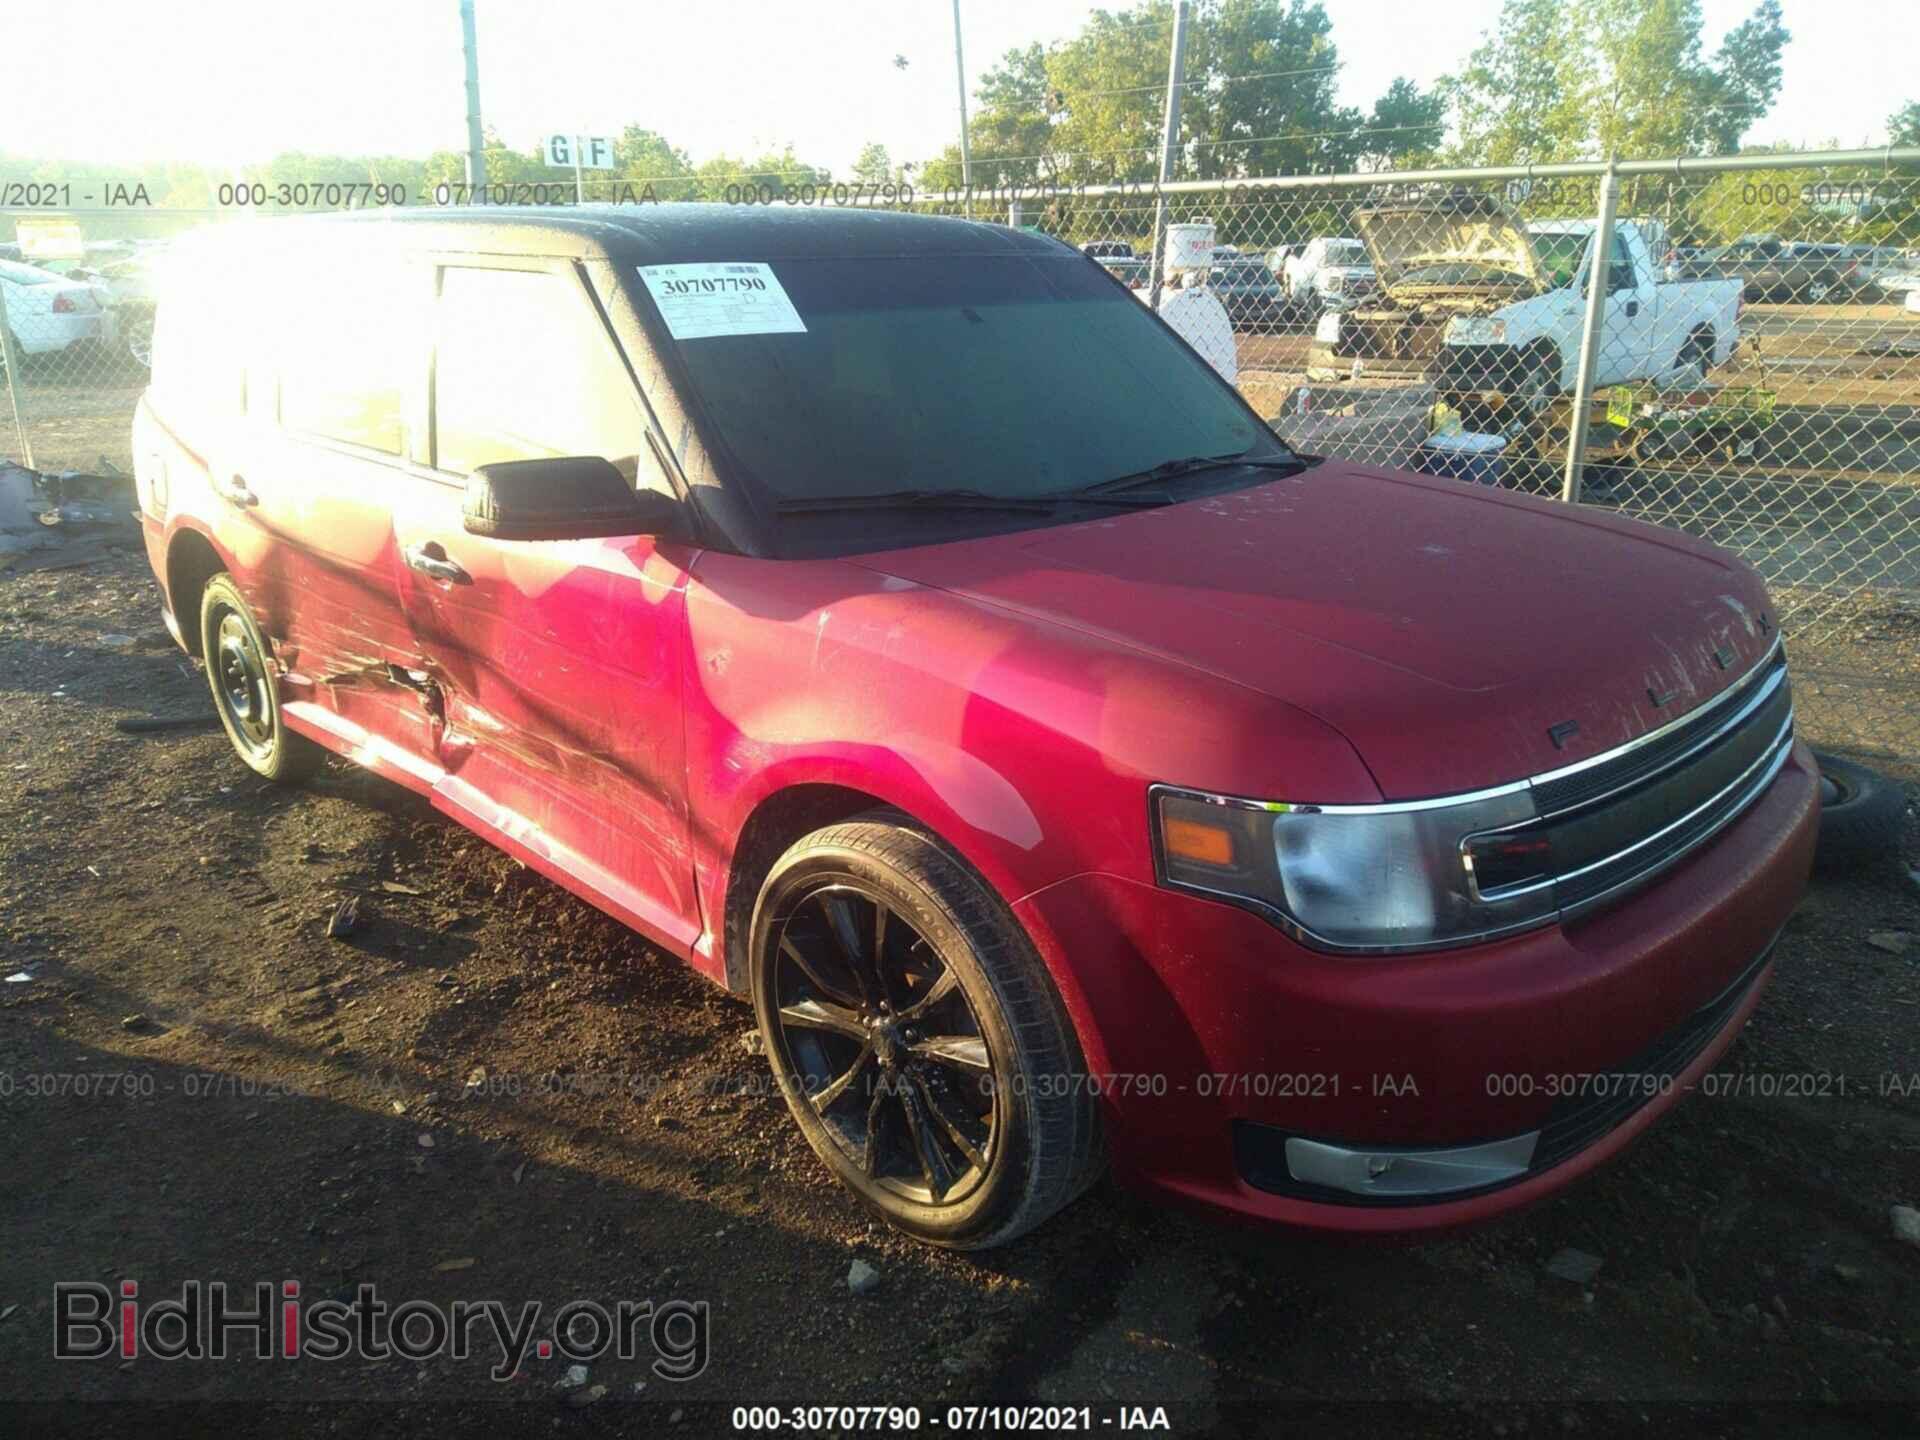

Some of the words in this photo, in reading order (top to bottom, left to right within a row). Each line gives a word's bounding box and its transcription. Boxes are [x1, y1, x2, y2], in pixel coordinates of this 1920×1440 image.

[551, 135, 569, 164] G
[590, 137, 606, 165] F
[661, 278, 767, 295] 30707790
